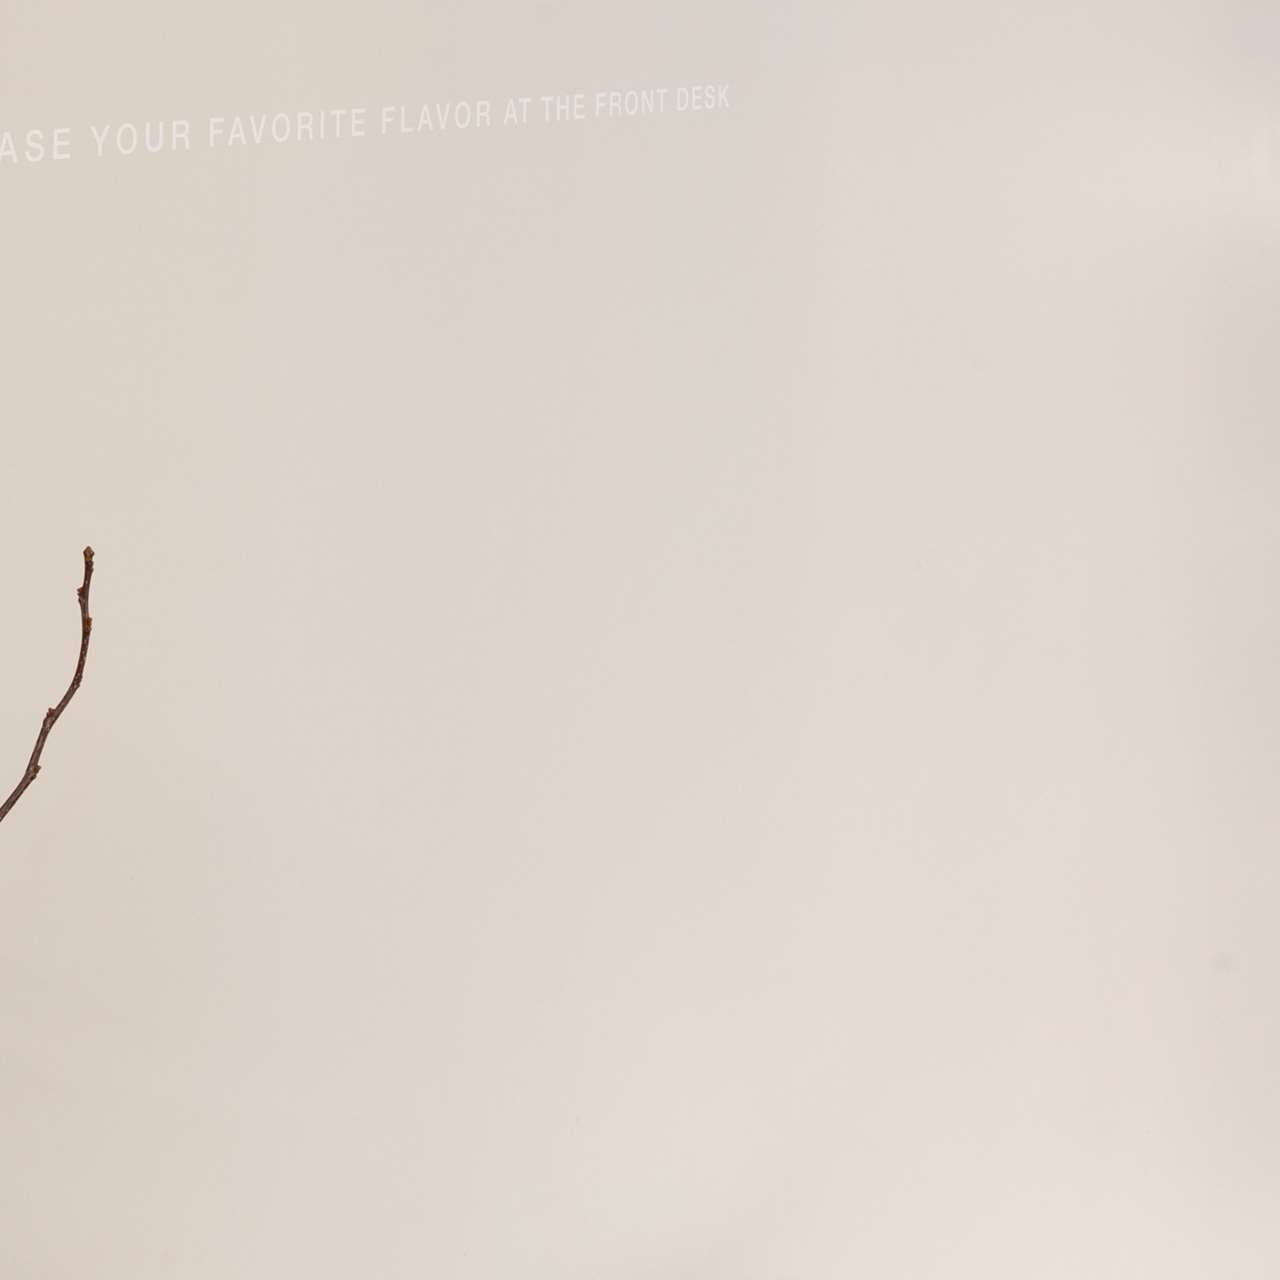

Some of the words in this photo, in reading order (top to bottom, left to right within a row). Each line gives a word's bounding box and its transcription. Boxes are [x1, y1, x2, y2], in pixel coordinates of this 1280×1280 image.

[89, 119, 192, 158] YOUR
[208, 107, 366, 148] FAVORITE
[381, 99, 491, 135] FLAVOR
[503, 97, 532, 127] AT
[540, 93, 585, 121] THE
[594, 87, 670, 118] FRONT
[675, 83, 730, 112] DESK
